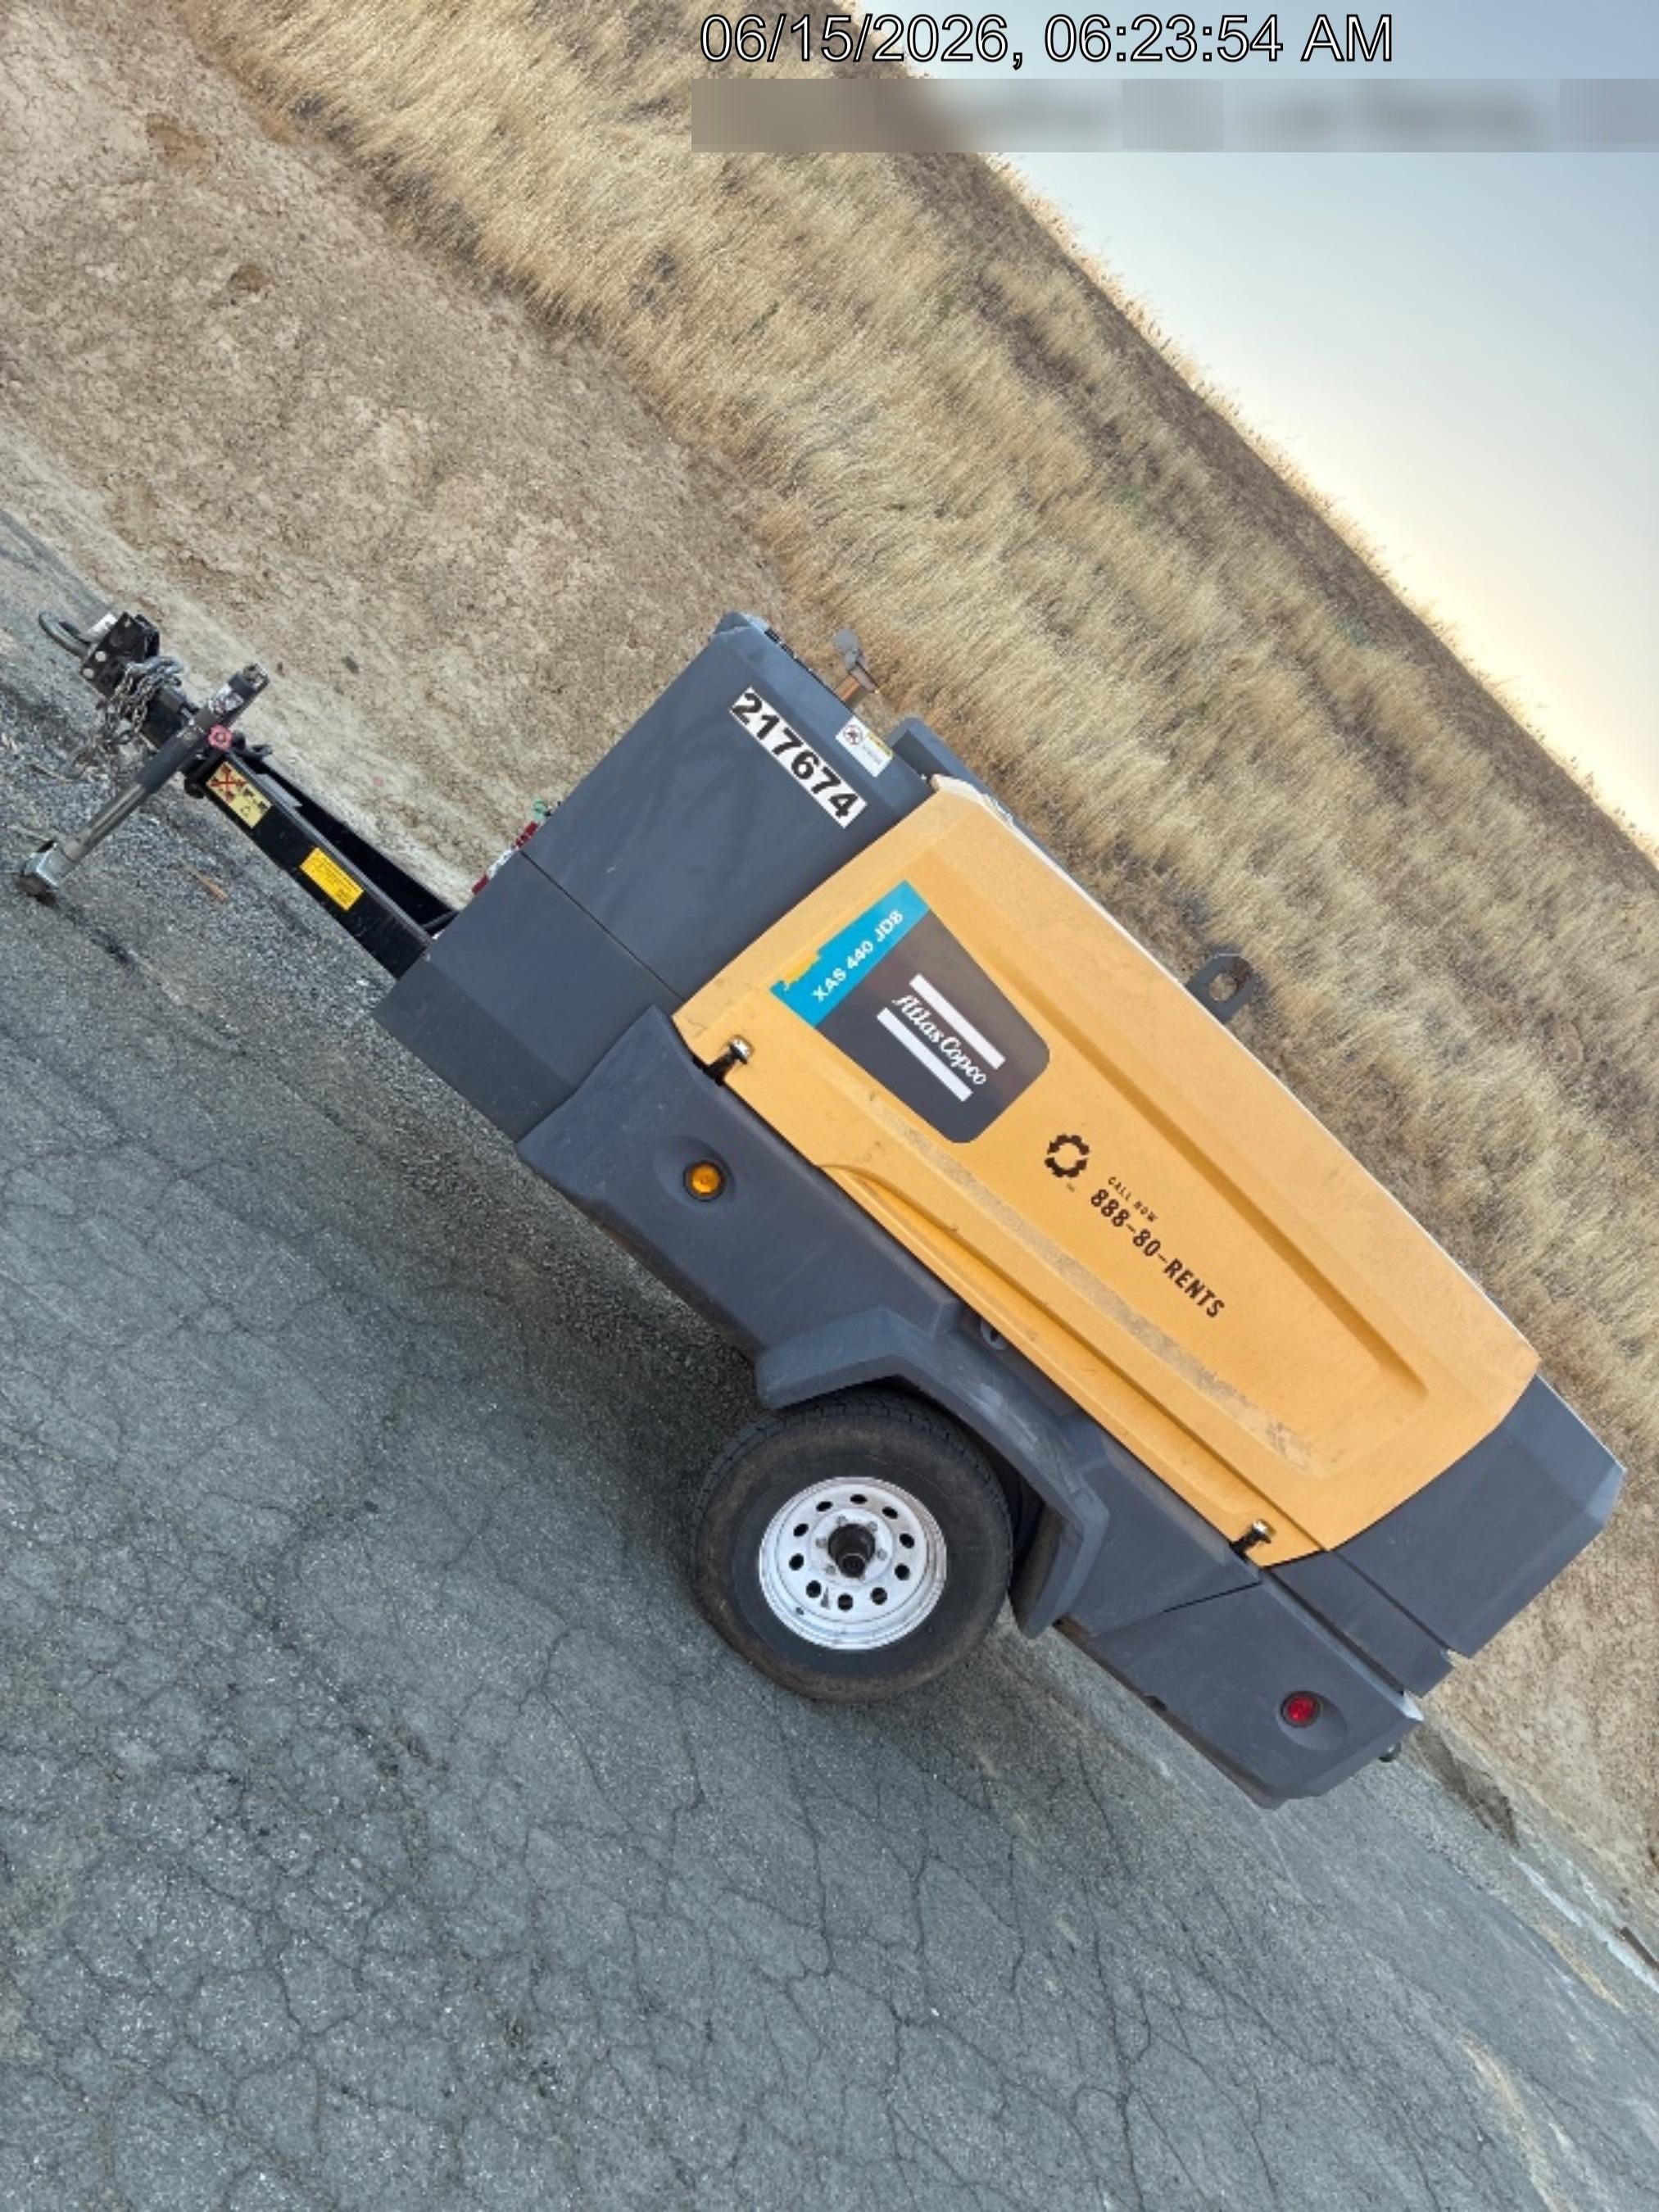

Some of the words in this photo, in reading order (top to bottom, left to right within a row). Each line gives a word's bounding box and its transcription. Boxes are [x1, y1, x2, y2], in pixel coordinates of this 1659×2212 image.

[732, 692, 859, 818] 217674
[811, 968, 846, 1002] XAS
[847, 941, 873, 969] 440
[874, 909, 903, 942] JD8
[891, 995, 944, 1043] Atlas
[941, 1036, 986, 1084] Copco
[1108, 1176, 1131, 1203] CALL
[1133, 1199, 1158, 1223] NOW
[1090, 1189, 1226, 1318] 888-80-RENTS
